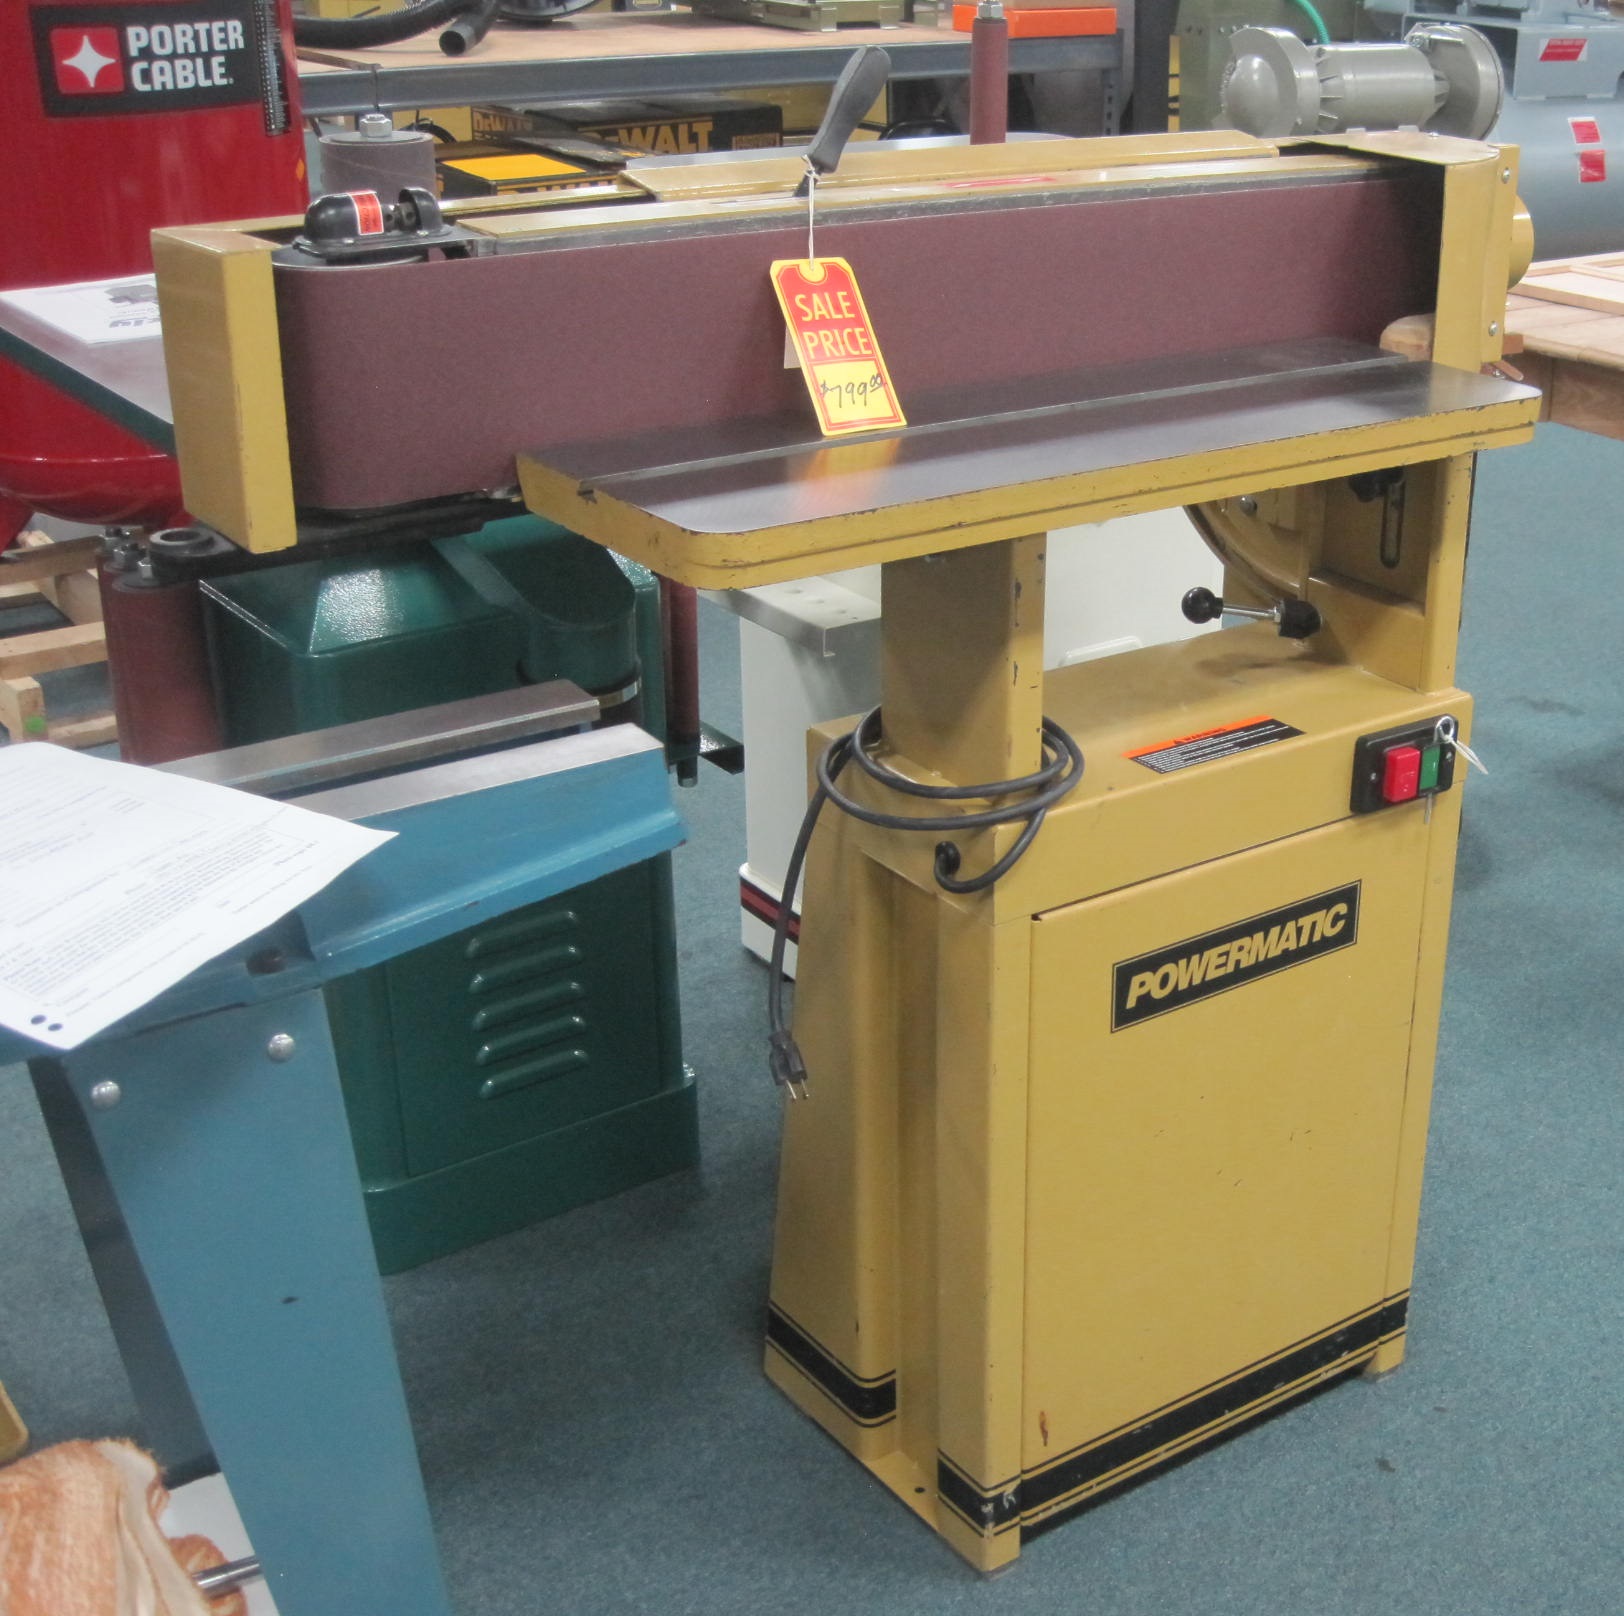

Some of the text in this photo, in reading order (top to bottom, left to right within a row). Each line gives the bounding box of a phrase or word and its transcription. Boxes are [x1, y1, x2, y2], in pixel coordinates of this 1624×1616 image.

[126, 20, 245, 56] PORTER
[795, 291, 855, 322] SALE
[803, 328, 873, 360] PRICE
[1126, 902, 1348, 1009] POWERMATIC
